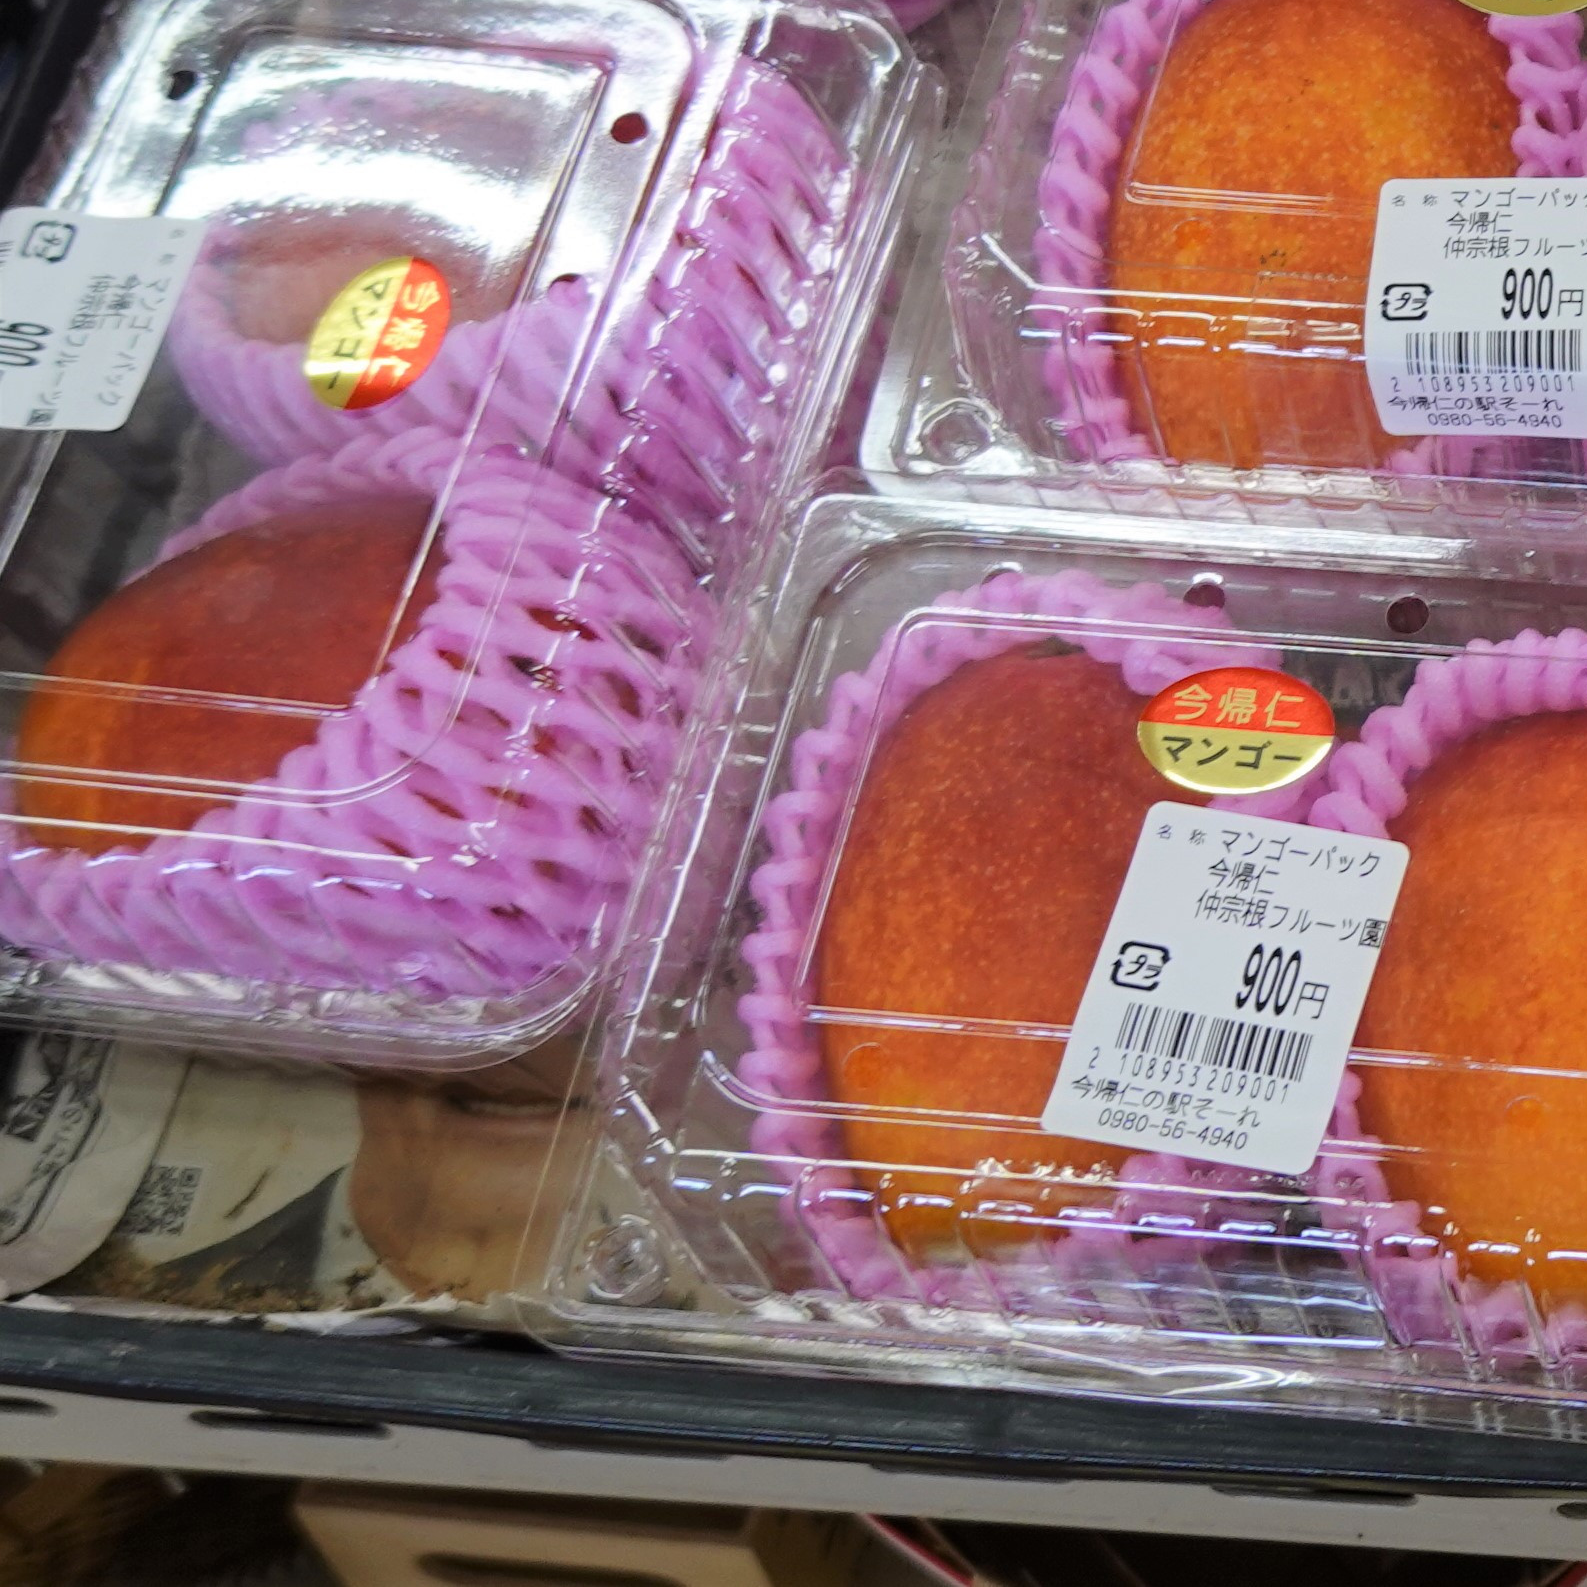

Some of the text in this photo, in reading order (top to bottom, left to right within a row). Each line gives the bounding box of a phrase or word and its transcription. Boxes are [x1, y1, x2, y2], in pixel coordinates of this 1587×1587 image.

[1446, 210, 1513, 235] 今帰仁
[1500, 267, 1584, 321] 900円
[1387, 394, 1564, 413] 今帰仁の駅そーれ
[1427, 412, 1562, 429] 0980-56-4940
[1172, 683, 1305, 731] 今帰仁
[1160, 734, 1303, 770] マンゴー
[1220, 828, 1381, 877] マンゴーパック
[1207, 861, 1280, 896] 今帰仁
[1194, 891, 1388, 948] 仲宗根フルーツ園
[1235, 942, 1330, 1019] 900円
[1071, 1076, 1261, 1129] 今帰仁の駅そーれ
[1098, 1108, 1249, 1151] 0980-56-4940
